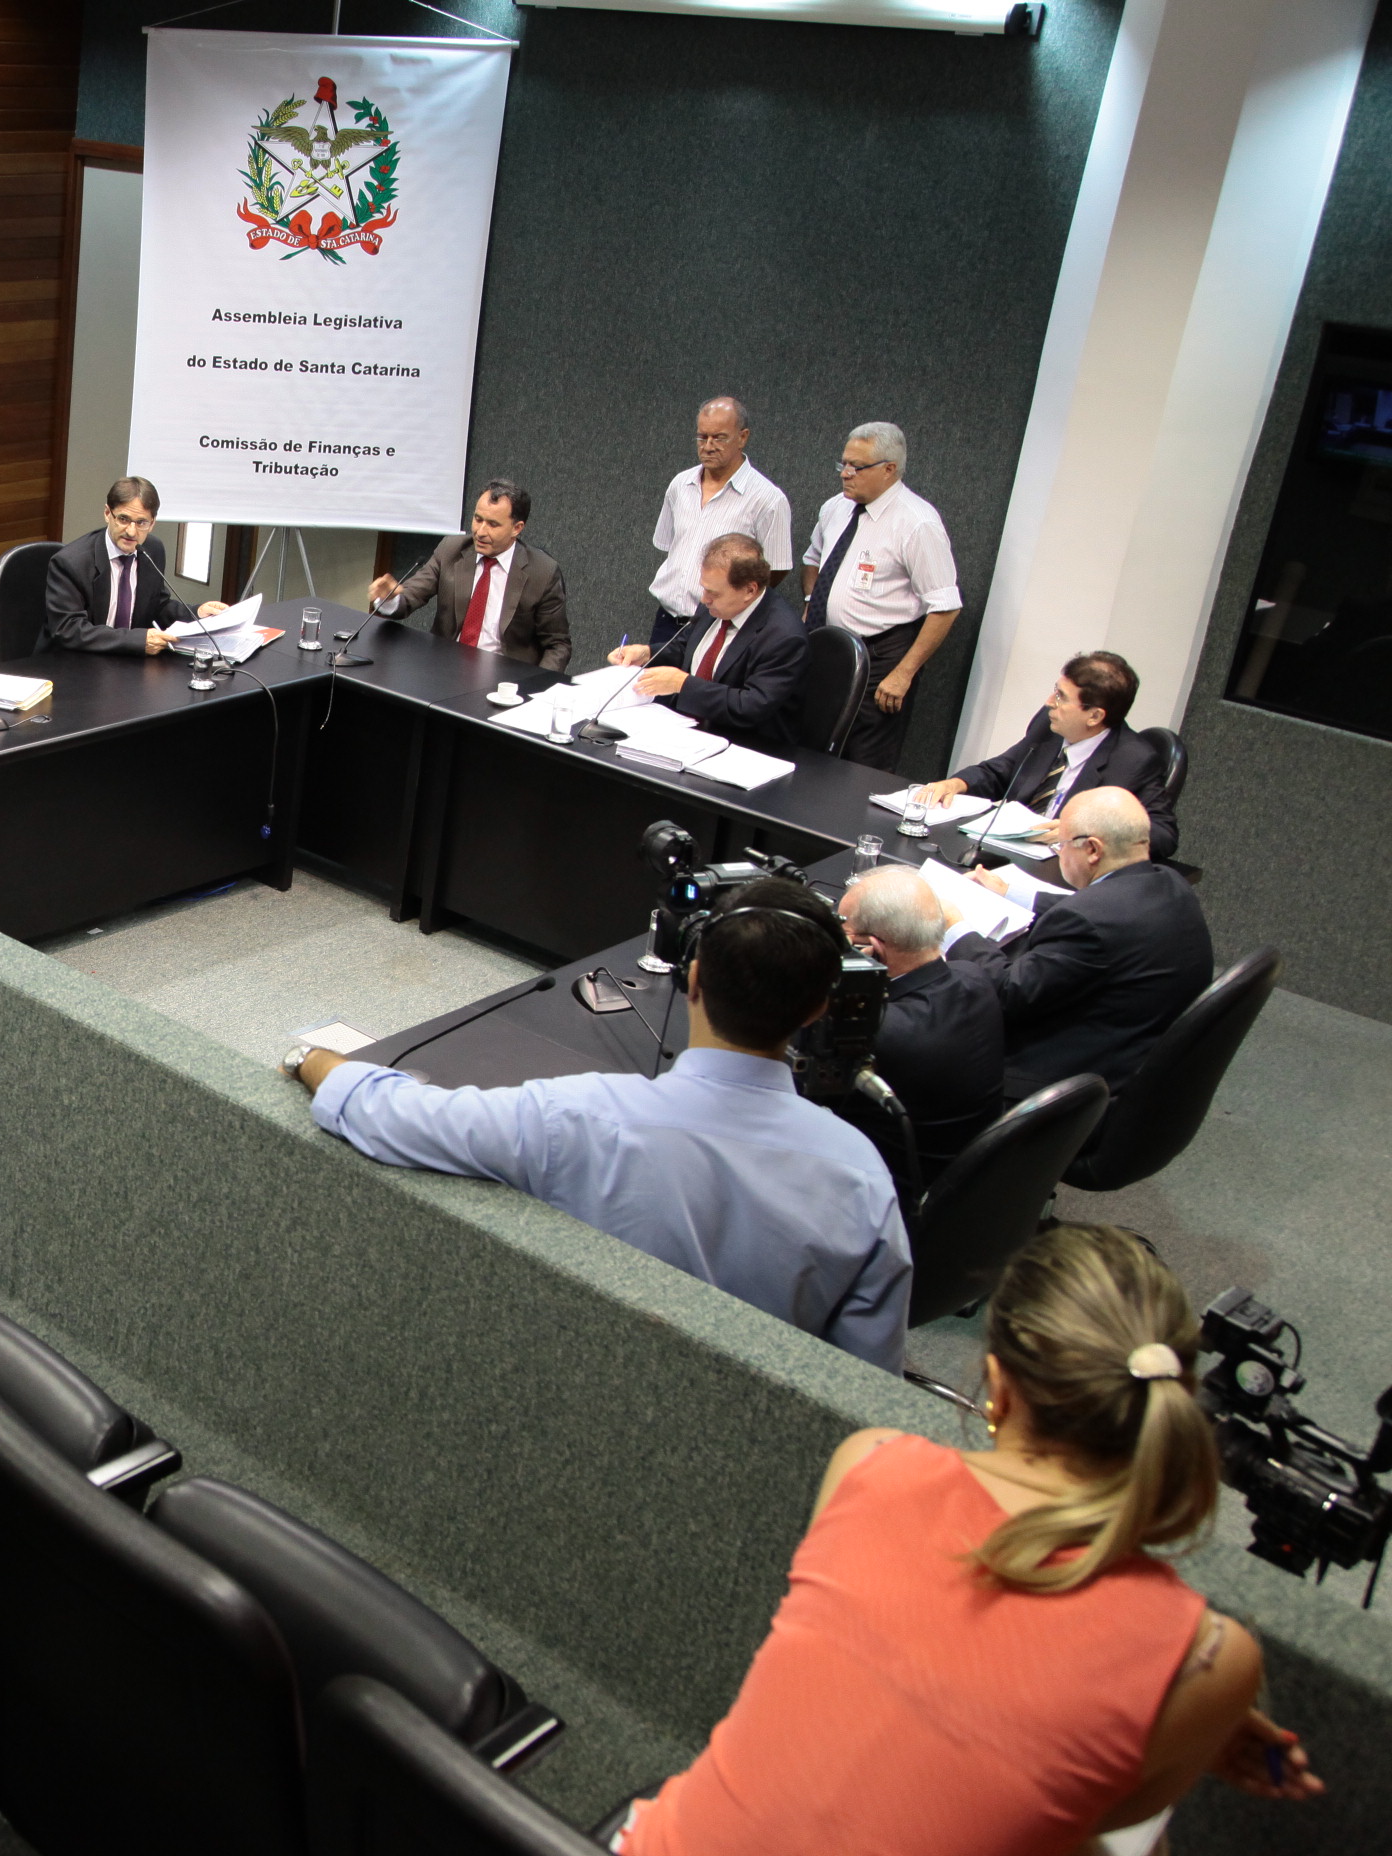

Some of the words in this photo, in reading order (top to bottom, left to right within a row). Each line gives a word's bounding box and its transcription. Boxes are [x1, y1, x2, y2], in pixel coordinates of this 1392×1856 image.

[250, 228, 287, 241] ESTADO
[287, 235, 303, 247] DE
[339, 232, 380, 246] CATARINA
[211, 308, 308, 326] Assembleia
[312, 312, 403, 331] Legislativa
[186, 354, 207, 368] do
[212, 355, 269, 371] Estado
[273, 358, 294, 373] de
[298, 359, 346, 375] Santa
[351, 361, 421, 378] Catarina
[199, 434, 278, 452] Comissão
[282, 438, 303, 453] de
[307, 440, 381, 459] Finanças
[385, 446, 396, 457] e
[252, 460, 339, 480] Tributação
